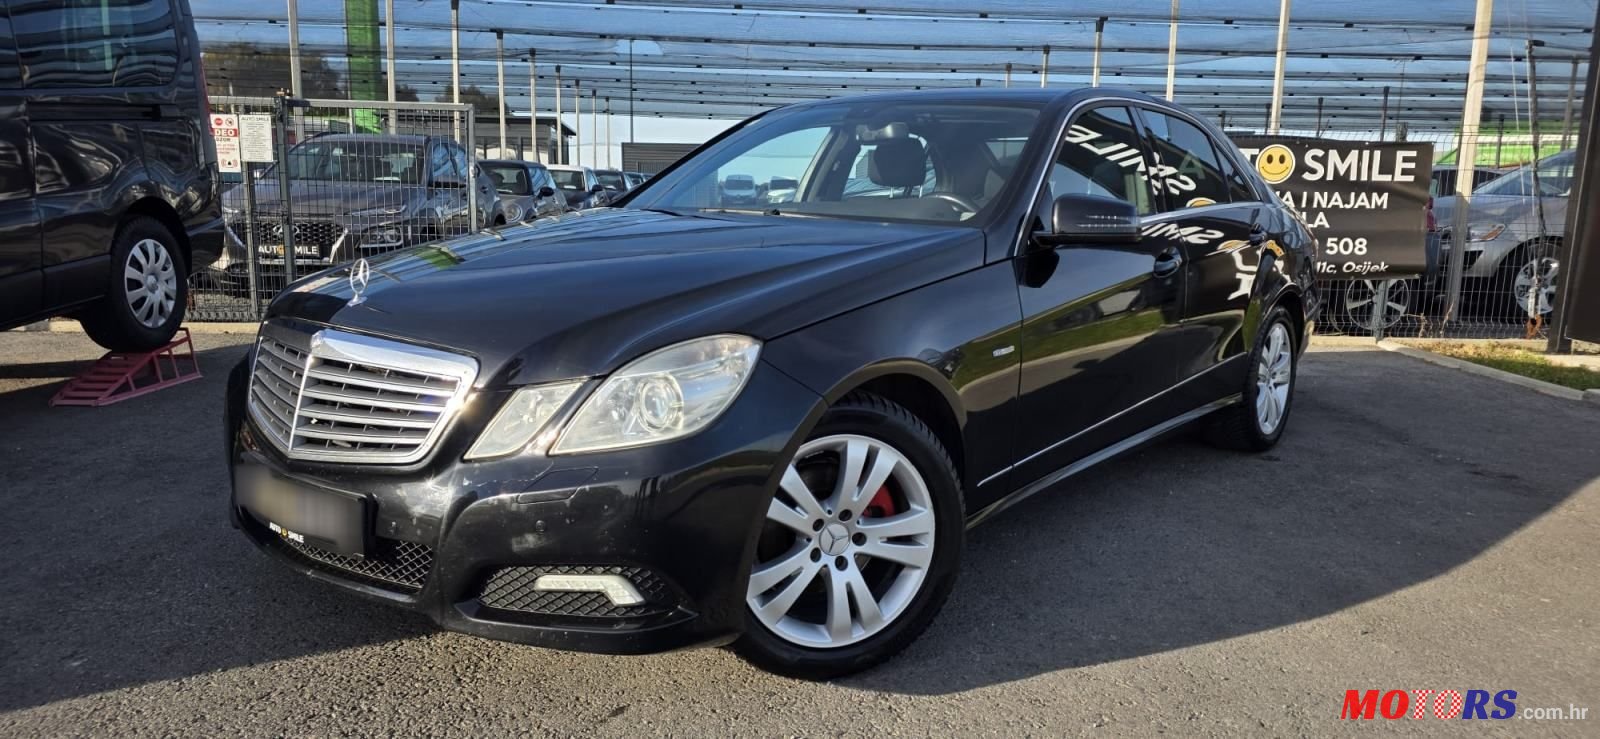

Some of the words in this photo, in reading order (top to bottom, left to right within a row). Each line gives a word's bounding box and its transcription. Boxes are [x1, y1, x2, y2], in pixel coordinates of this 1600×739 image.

[214, 128, 235, 137] DEO
[1302, 148, 1418, 182] SMILE
[1301, 191, 1308, 209] I
[1313, 191, 1389, 209] NAJAM
[1302, 211, 1330, 228] LA
[294, 244, 319, 255] MILE
[1325, 237, 1368, 256] 508
[1342, 261, 1389, 274] Osijek
